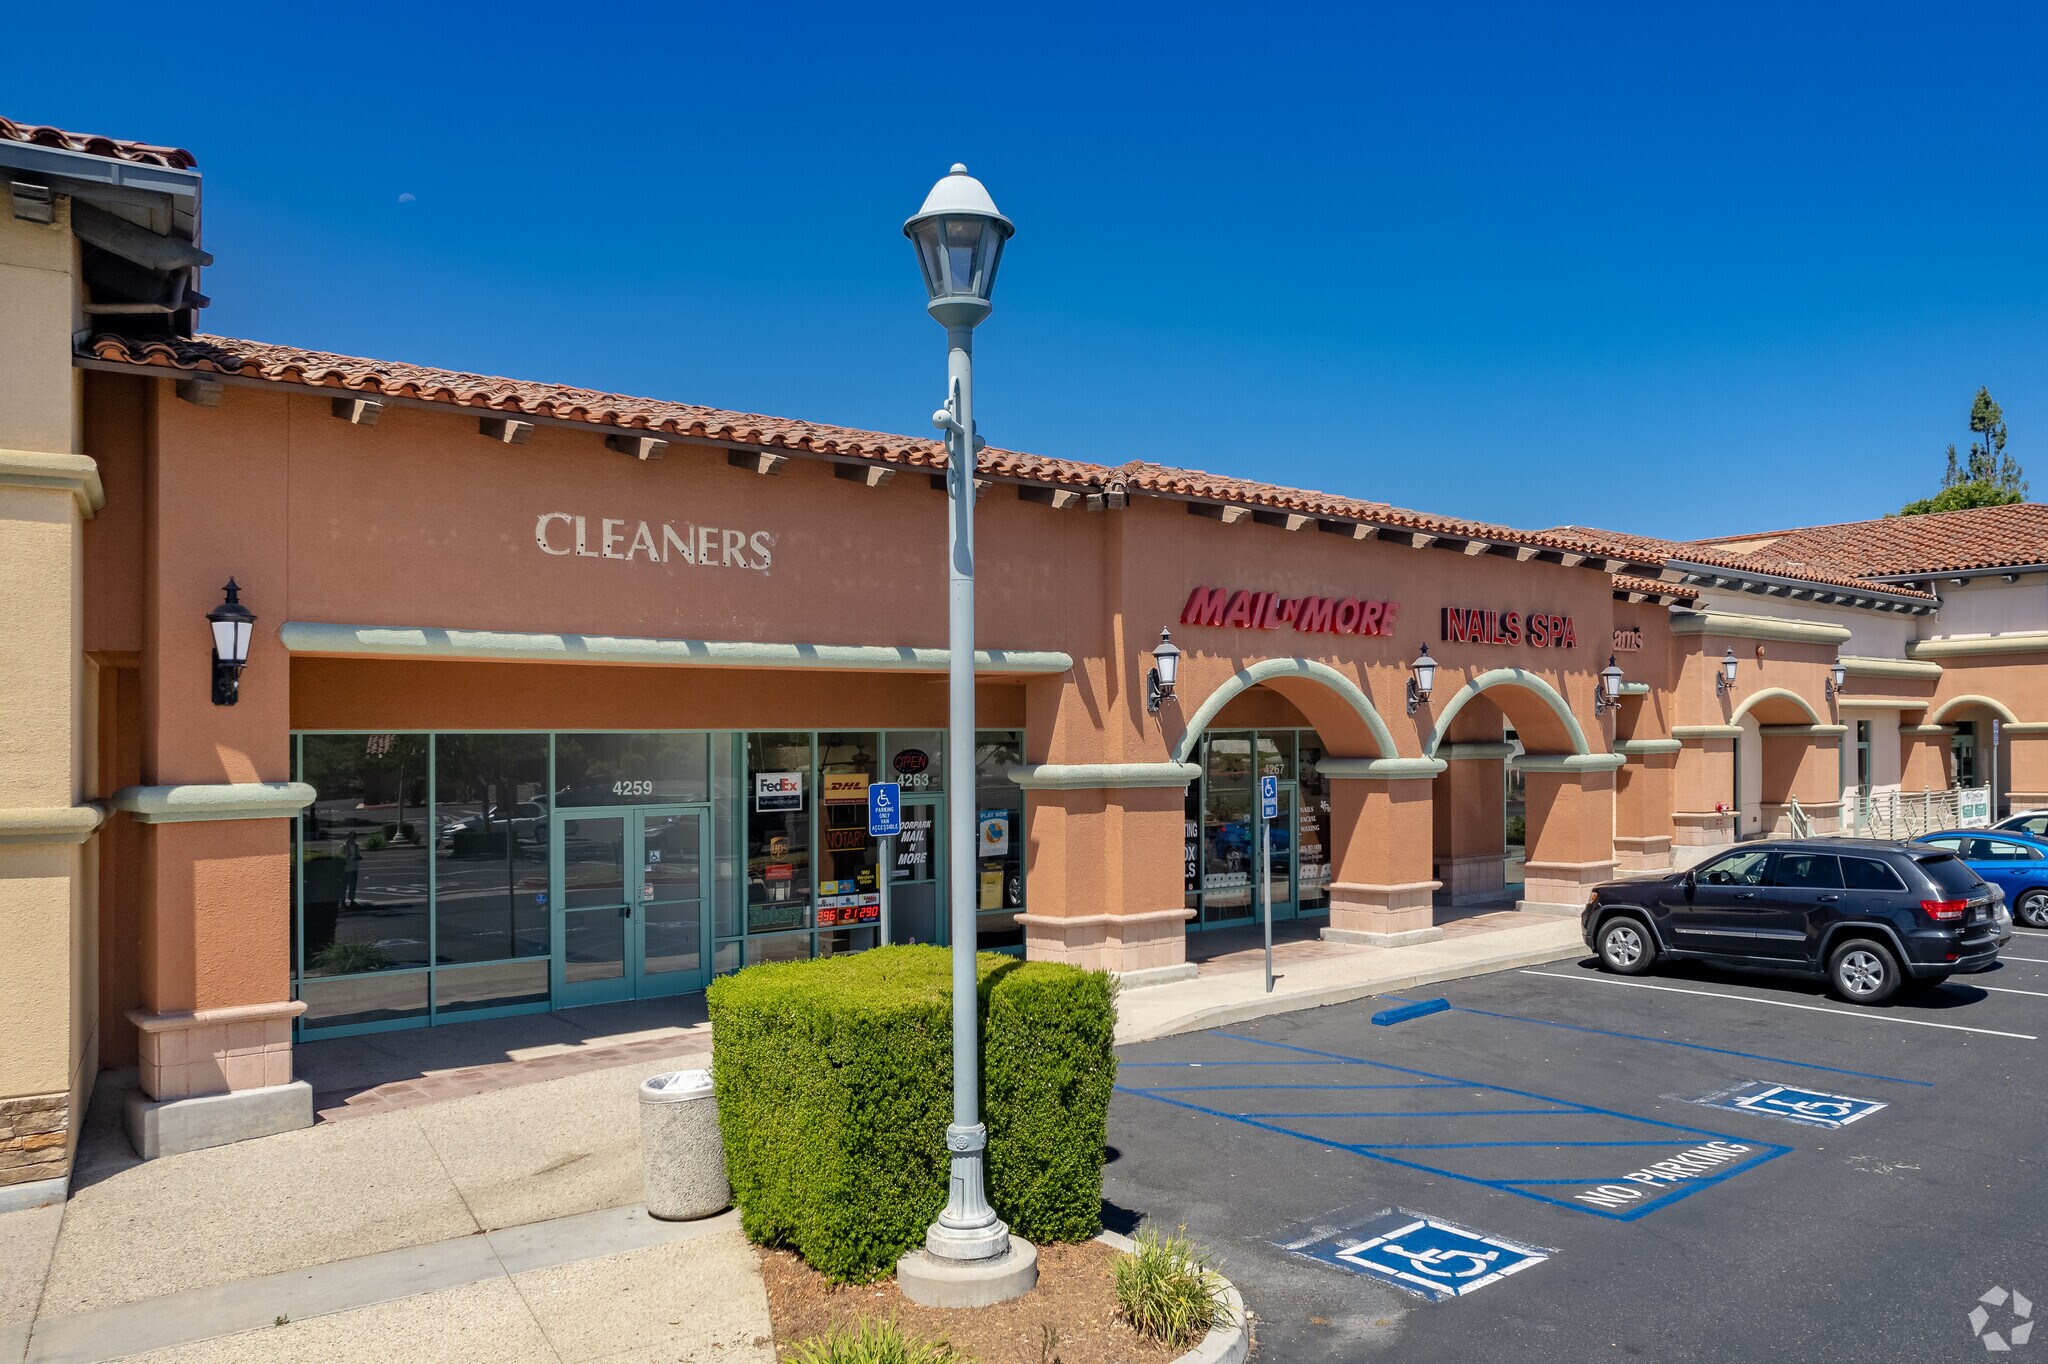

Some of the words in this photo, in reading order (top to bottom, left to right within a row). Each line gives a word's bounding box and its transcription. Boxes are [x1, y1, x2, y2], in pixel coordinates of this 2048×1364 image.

[535, 511, 774, 572] CLEANERS
[1179, 586, 1280, 630] MAIL
[1279, 598, 1301, 622] N
[1293, 595, 1400, 637] MORE
[1441, 606, 1523, 647] NAILS
[1525, 613, 1578, 649] SPA
[895, 755, 927, 768] OPEN
[1263, 763, 1285, 775] 4267
[760, 778, 798, 792] FedEx
[830, 782, 862, 791] DHL
[897, 773, 929, 787] 4263
[612, 780, 653, 796] 4259
[871, 823, 899, 832] ACCESSIBLE
[900, 820, 932, 830] OORPARK
[826, 830, 867, 849] NOTARY
[901, 830, 925, 842] MAIL
[772, 843, 788, 857] ups
[909, 843, 917, 852] N
[898, 852, 928, 865] MORE
[1574, 1184, 1643, 1209] NO
[1622, 1140, 1750, 1188] PARKING
